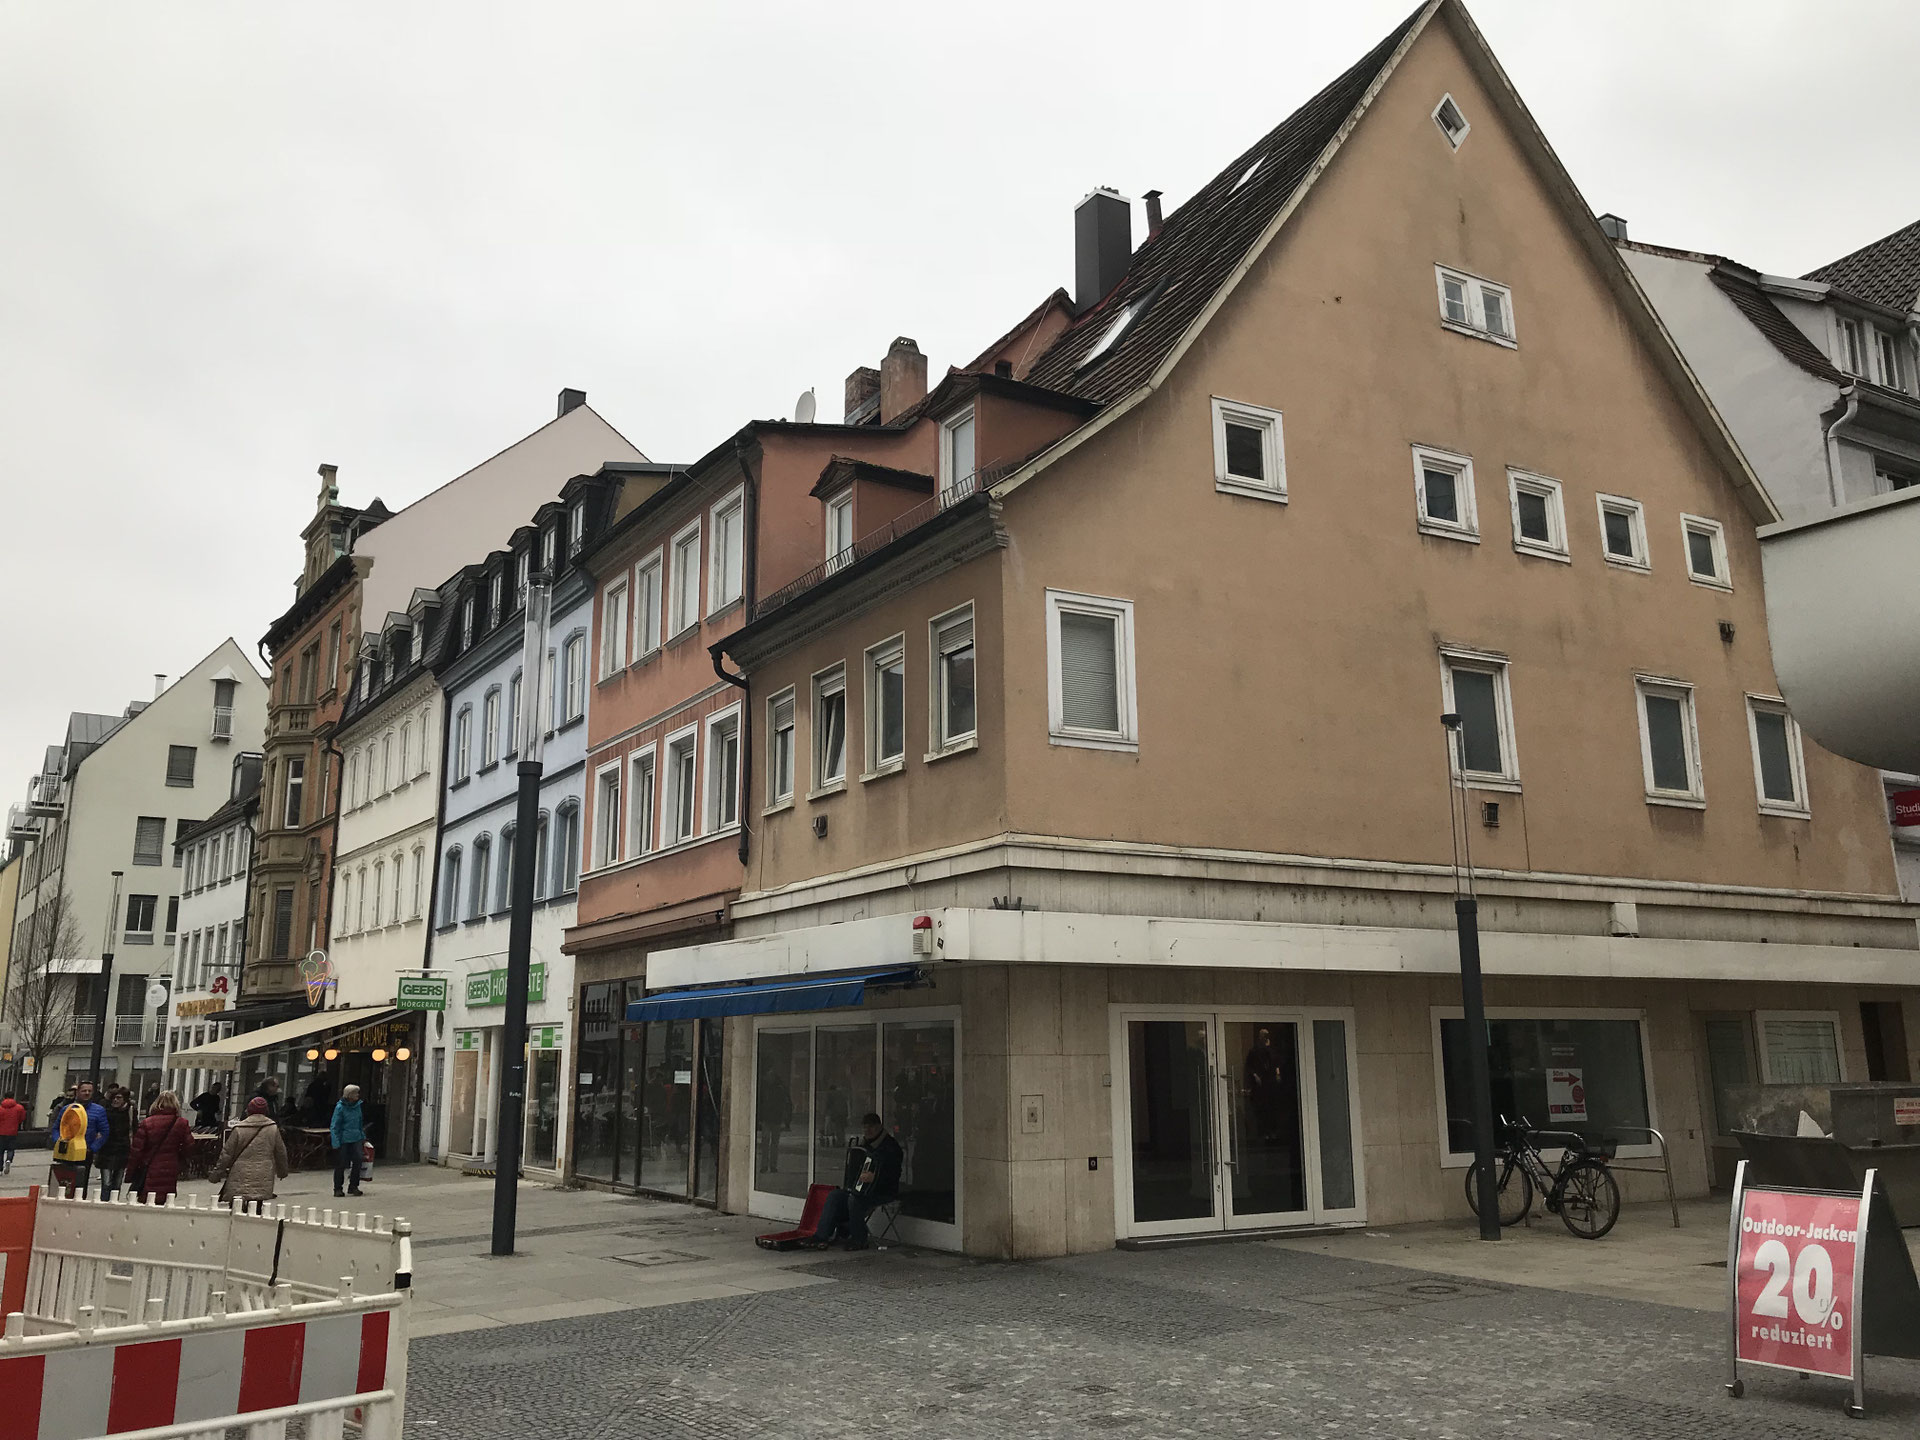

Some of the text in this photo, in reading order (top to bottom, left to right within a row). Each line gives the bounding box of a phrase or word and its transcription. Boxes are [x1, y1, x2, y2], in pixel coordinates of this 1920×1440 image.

[402, 984, 443, 996] GEERS
[468, 979, 489, 1000] GEERS
[401, 1000, 442, 1008] HÖRGERÄTE
[1743, 1217, 1857, 1242] Outdoor-Jacken
[1752, 1240, 1843, 1329] 20%
[1752, 1324, 1833, 1349] reduziert
